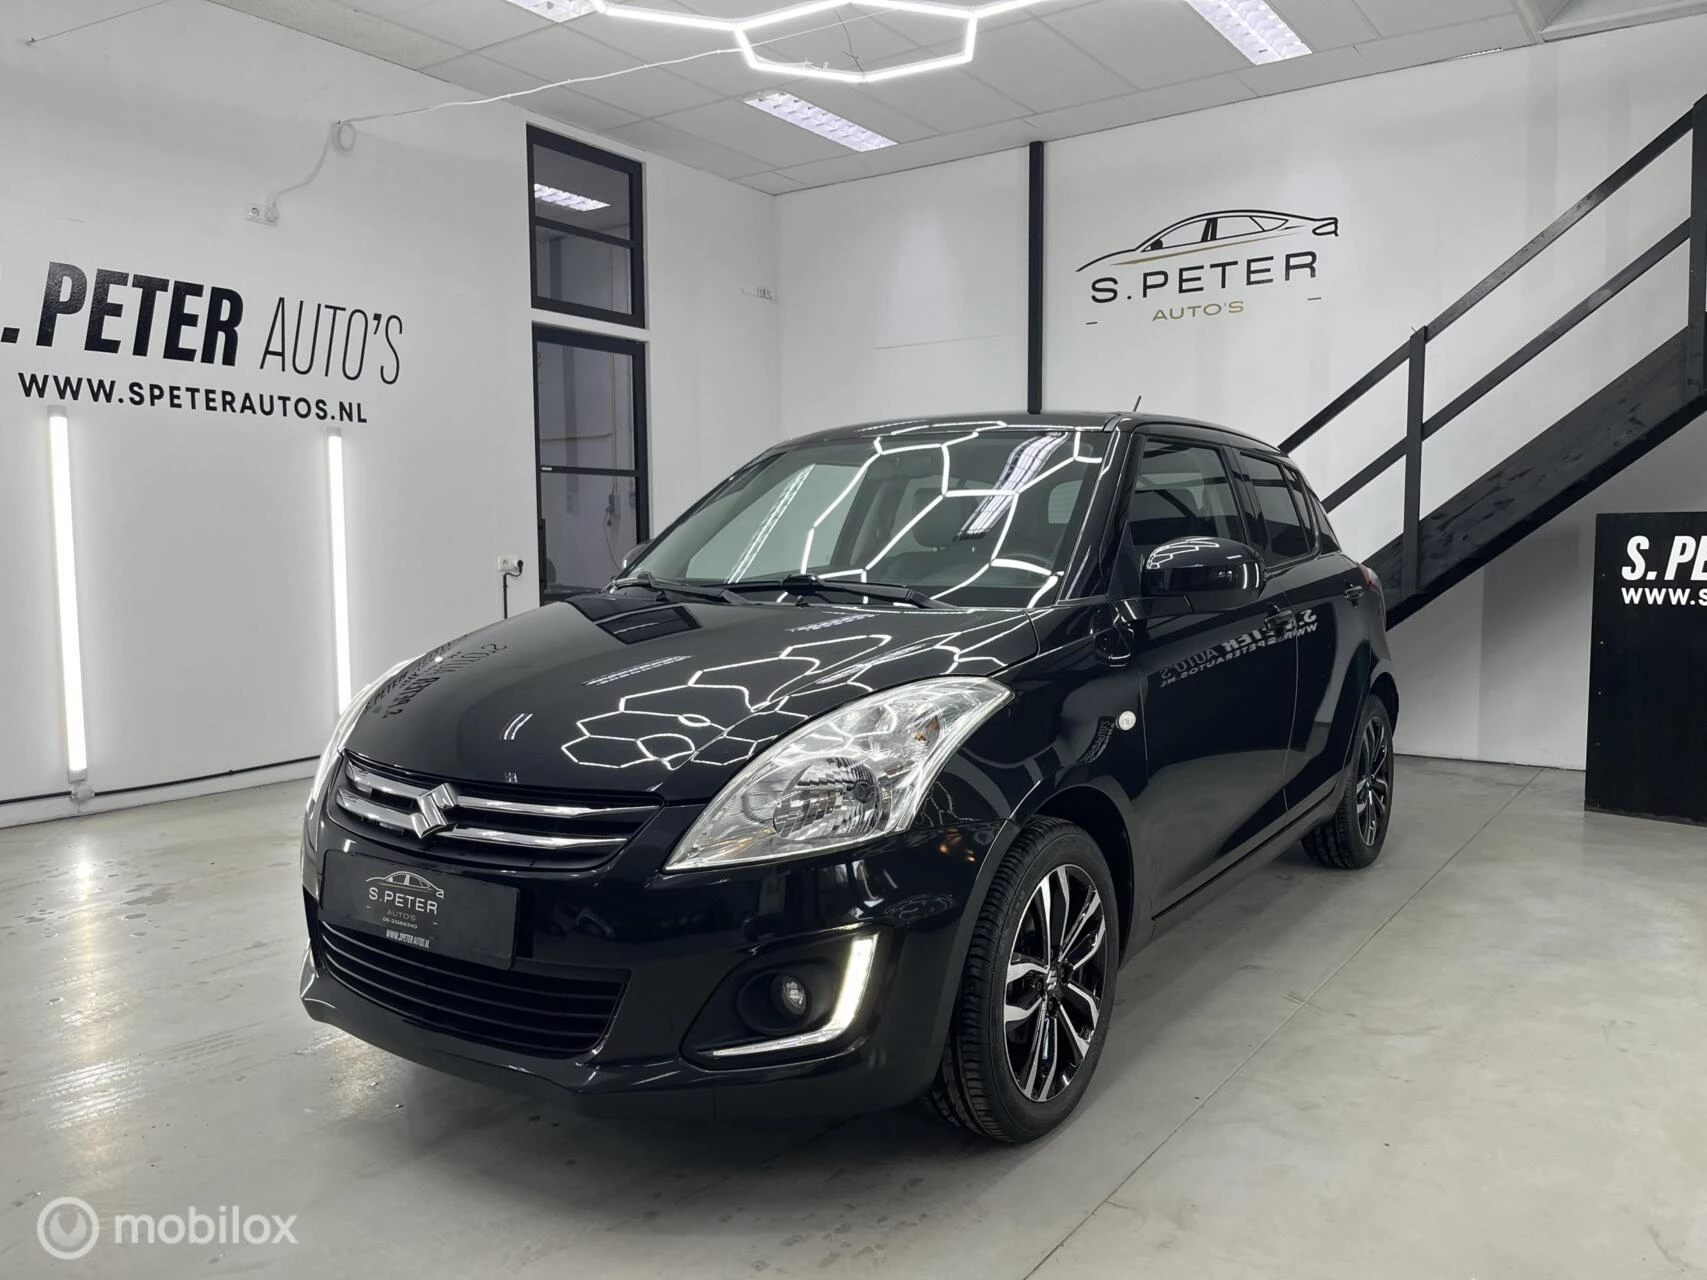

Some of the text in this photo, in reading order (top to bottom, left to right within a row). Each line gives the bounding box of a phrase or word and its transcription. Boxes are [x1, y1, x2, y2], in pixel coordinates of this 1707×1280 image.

[1152, 300, 1245, 322] AUTO'S
[259, 296, 403, 385] AUTO'S
[18, 372, 368, 424] WWW.SPETERAUTOS.NL
